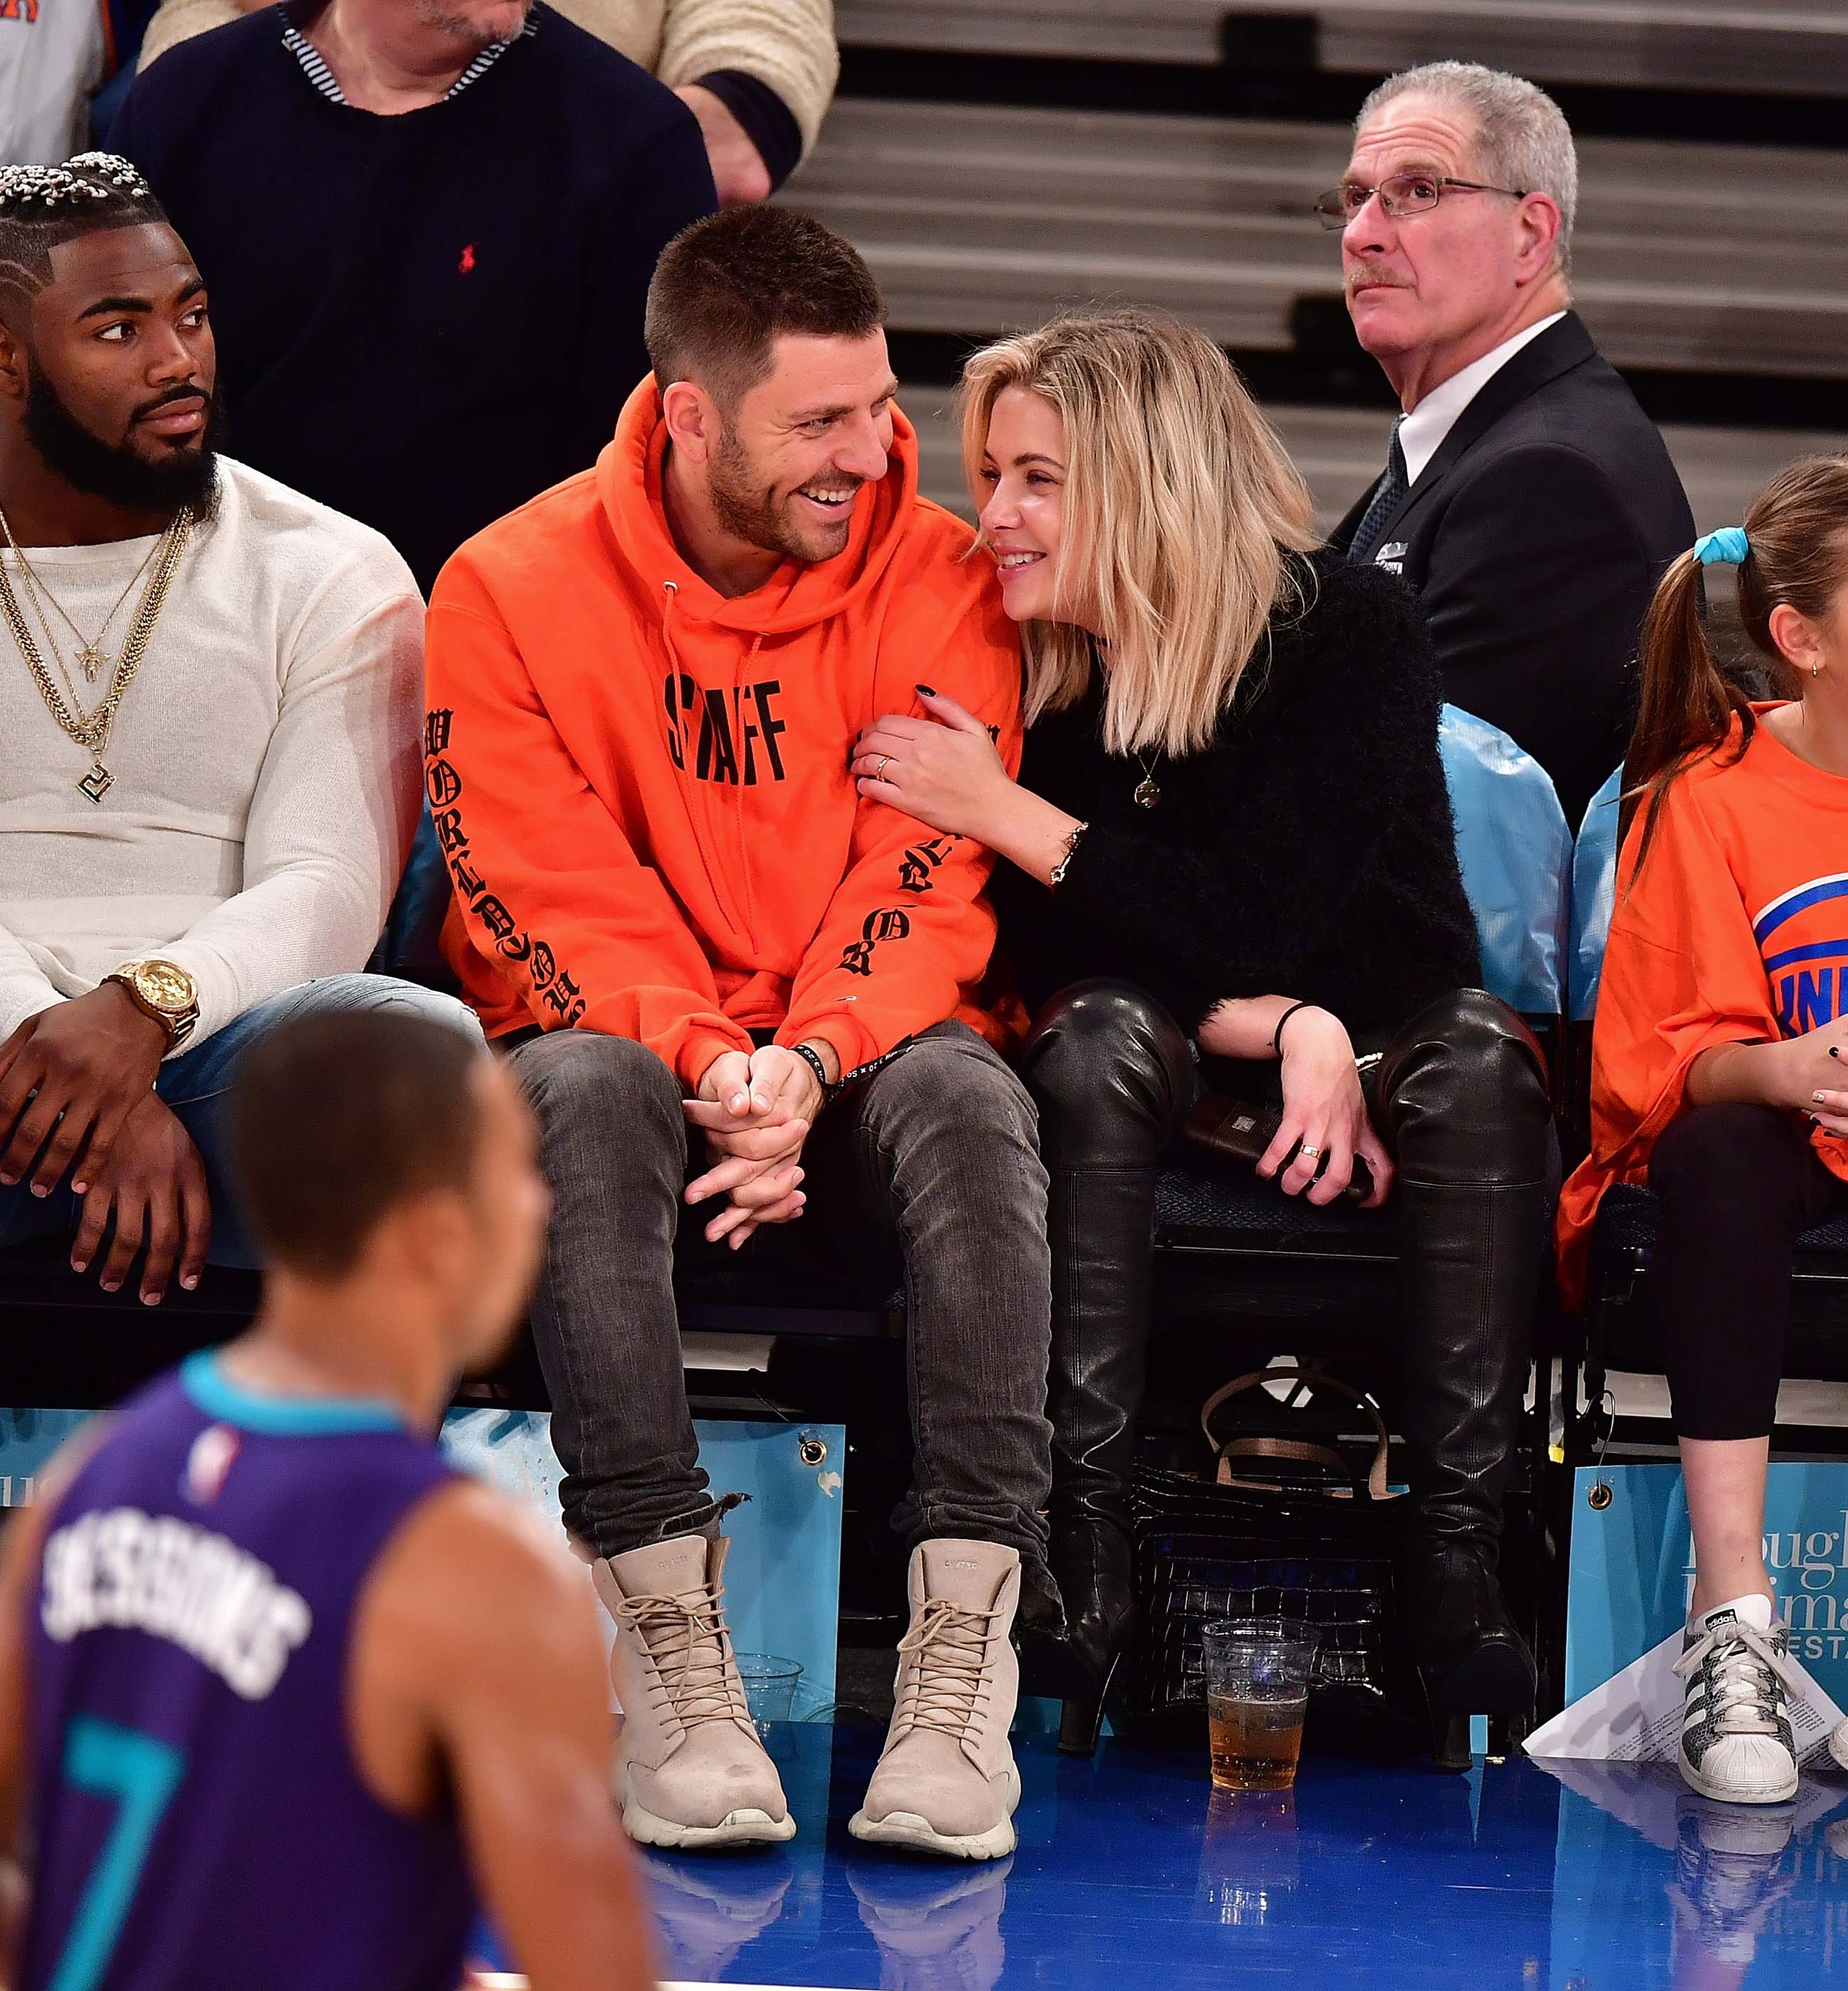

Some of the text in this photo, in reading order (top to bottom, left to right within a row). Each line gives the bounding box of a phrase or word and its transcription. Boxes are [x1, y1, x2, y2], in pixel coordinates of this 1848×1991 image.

[664, 672, 786, 786] STAFF
[1707, 1615, 1736, 1630] adidas
[48, 1715, 188, 1991] 7
